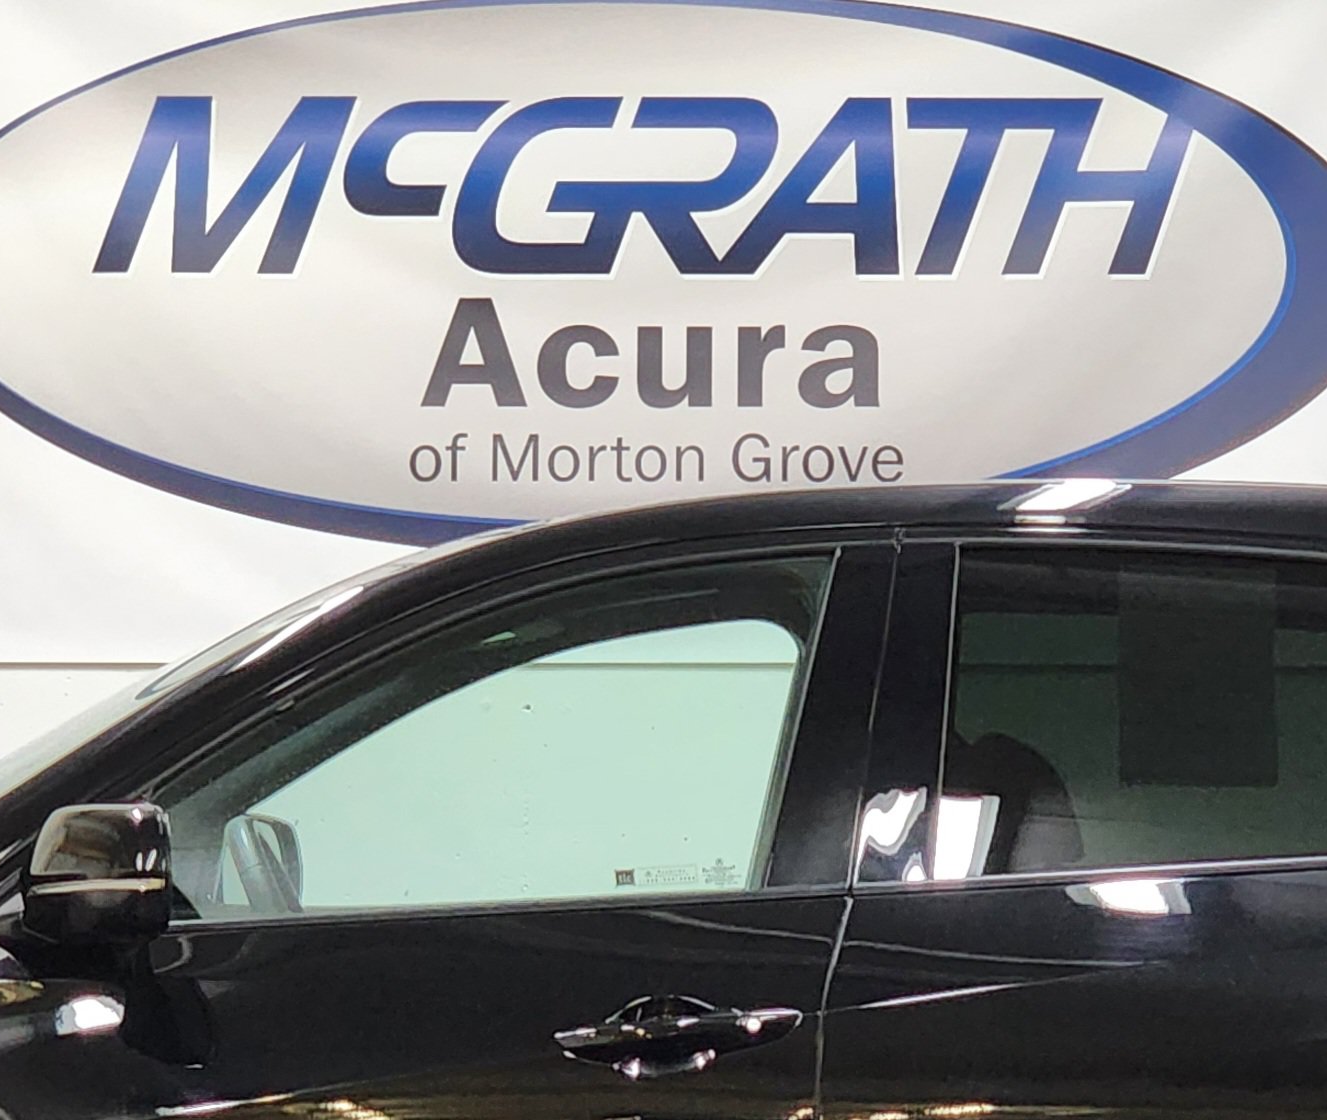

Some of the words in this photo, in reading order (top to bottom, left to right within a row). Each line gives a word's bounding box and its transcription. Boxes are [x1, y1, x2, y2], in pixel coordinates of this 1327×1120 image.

[420, 297, 880, 409] Acura
[409, 433, 469, 482] of
[492, 434, 704, 482] Morton
[732, 433, 905, 483] Grove
